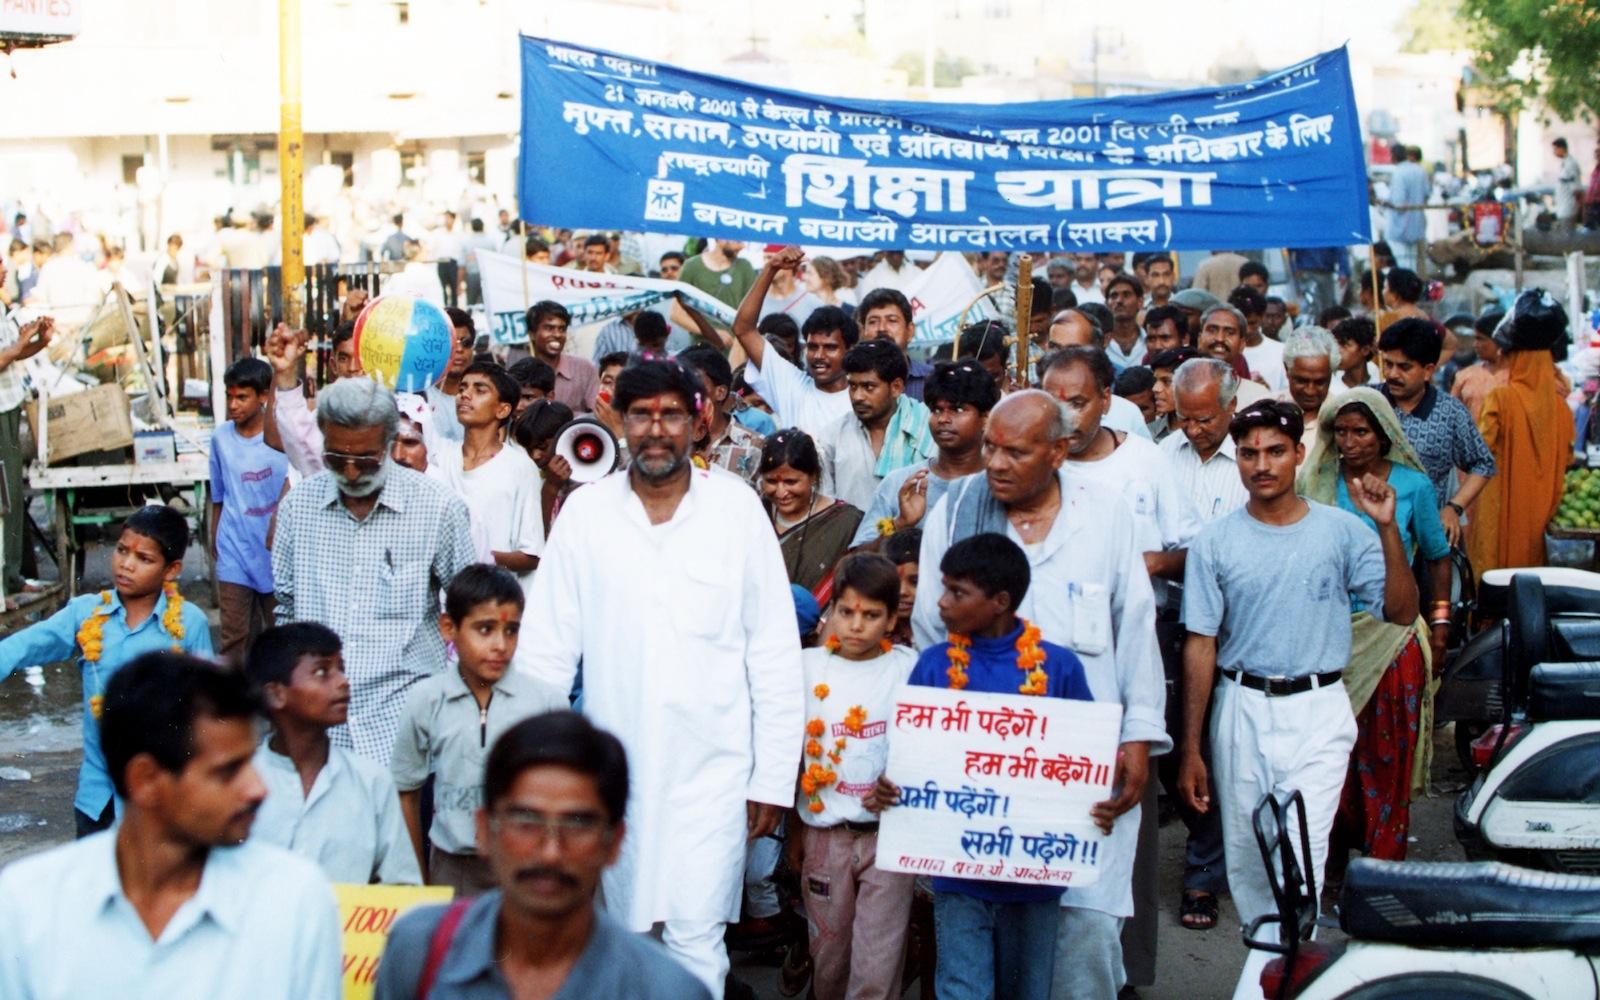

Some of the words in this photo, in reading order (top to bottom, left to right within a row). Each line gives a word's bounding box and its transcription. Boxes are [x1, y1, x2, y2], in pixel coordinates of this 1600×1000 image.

[604, 85, 625, 102] 21
[634, 88, 695, 112] जनवरी
[699, 98, 738, 117] 2001
[741, 96, 759, 119] से
[762, 97, 810, 125] केरल
[813, 105, 832, 125] से
[1048, 126, 1101, 146] 2001
[642, 113, 736, 149] समान,
[741, 123, 842, 154] उपयोगी
[849, 128, 891, 157] एवं
[1144, 131, 1263, 165] अधिकार
[1265, 121, 1288, 149] के
[1289, 113, 1334, 147] लिए
[781, 154, 975, 217] शिक्षा
[995, 169, 1217, 211] यात्रा
[691, 202, 789, 235] बचपन
[799, 215, 899, 243] बचाओ
[909, 215, 1051, 247] आन्दोलन
[895, 703, 937, 735] हम
[941, 700, 972, 733] भी
[964, 751, 1005, 782] हम
[1008, 747, 1039, 779] भी
[960, 826, 1013, 861] सभी
[899, 855, 944, 873] बचपन
